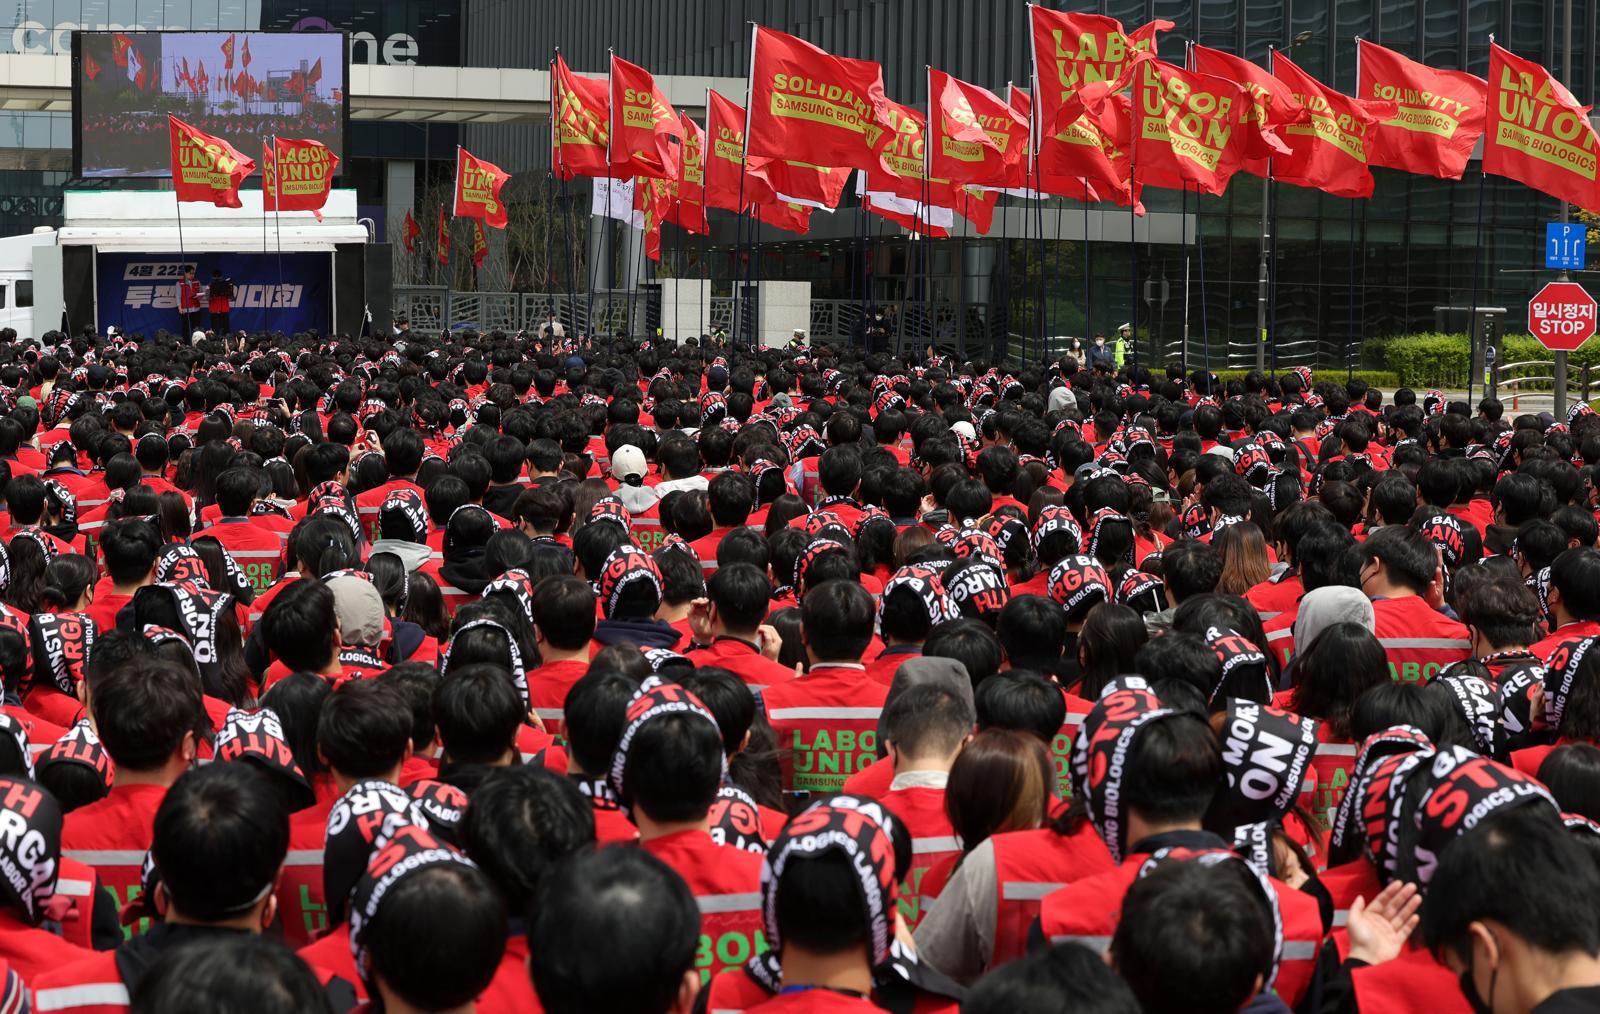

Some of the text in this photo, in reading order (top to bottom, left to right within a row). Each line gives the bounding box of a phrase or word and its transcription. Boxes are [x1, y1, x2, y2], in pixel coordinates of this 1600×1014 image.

[776, 98, 833, 118] SAMSUNG
[1374, 82, 1470, 117] SOLIDARITY
[1531, 138, 1596, 172] BIOLOGICS
[1533, 303, 1593, 319] 일시정지
[1540, 320, 1585, 335] STOP
[194, 613, 212, 664] ON
[339, 652, 373, 665] LOGICS
[1560, 637, 1595, 693] BIOLOGICS
[1104, 725, 1137, 818] BIOLOGICS
[1240, 731, 1294, 800] ON
[1274, 744, 1310, 809] SAMSUNG
